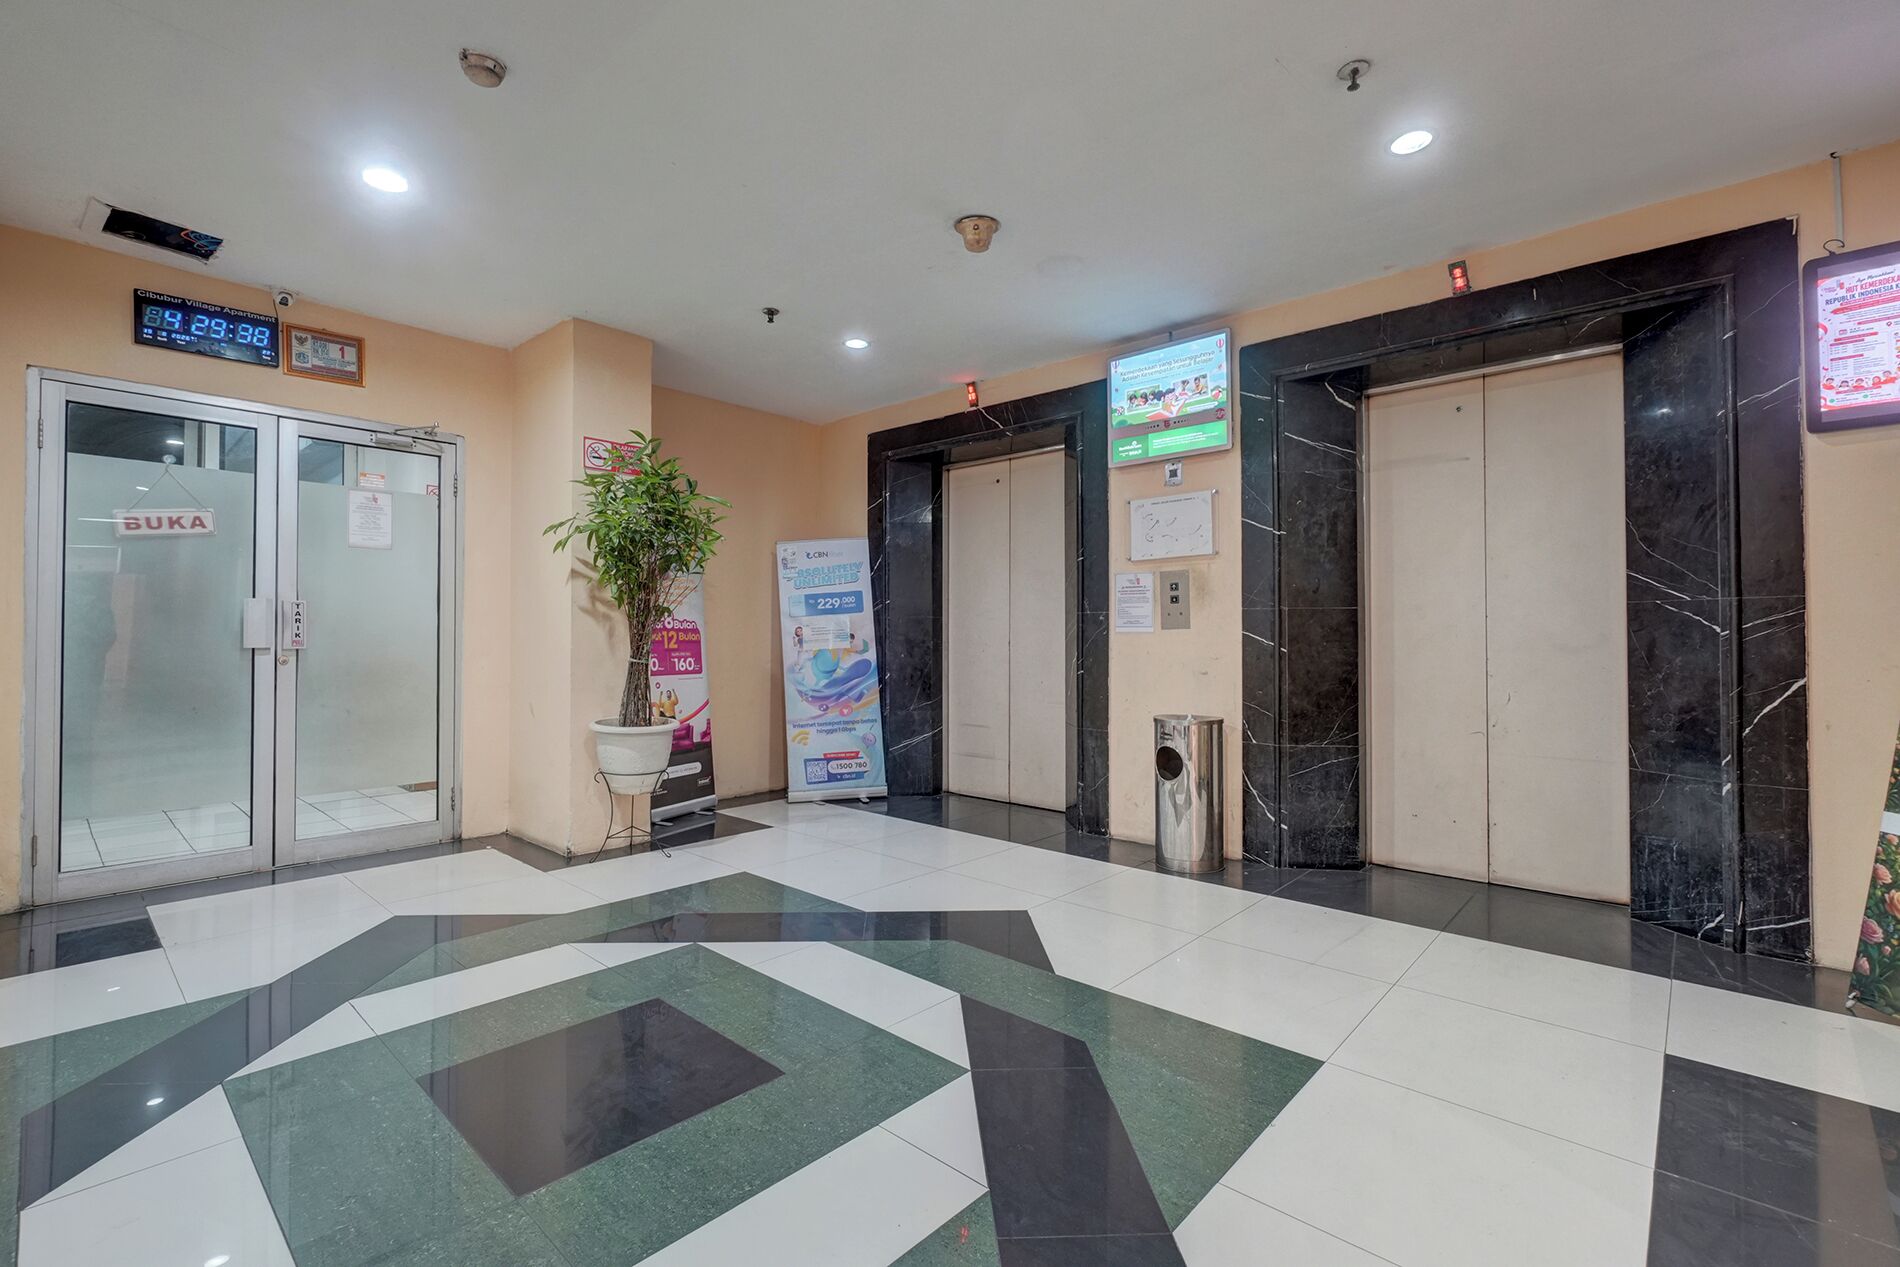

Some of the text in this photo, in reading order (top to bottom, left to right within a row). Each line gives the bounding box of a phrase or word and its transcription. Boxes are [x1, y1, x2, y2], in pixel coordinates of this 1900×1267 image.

[1825, 293, 1857, 306] REPUBLIK
[1857, 284, 1894, 298] INDONESIA
[1846, 284, 1859, 294] HUT
[137, 290, 276, 323] Cibubur Village Apartment
[1158, 360, 1173, 370] yang
[123, 516, 207, 530] BUKA
[796, 561, 864, 578] BSOLUTELY
[793, 572, 859, 588] UNLIMITED
[674, 621, 697, 629] Bulan
[662, 631, 678, 649] 12
[679, 632, 700, 641] Bulan
[674, 658, 695, 671] 160
[816, 720, 842, 728] tercepat
